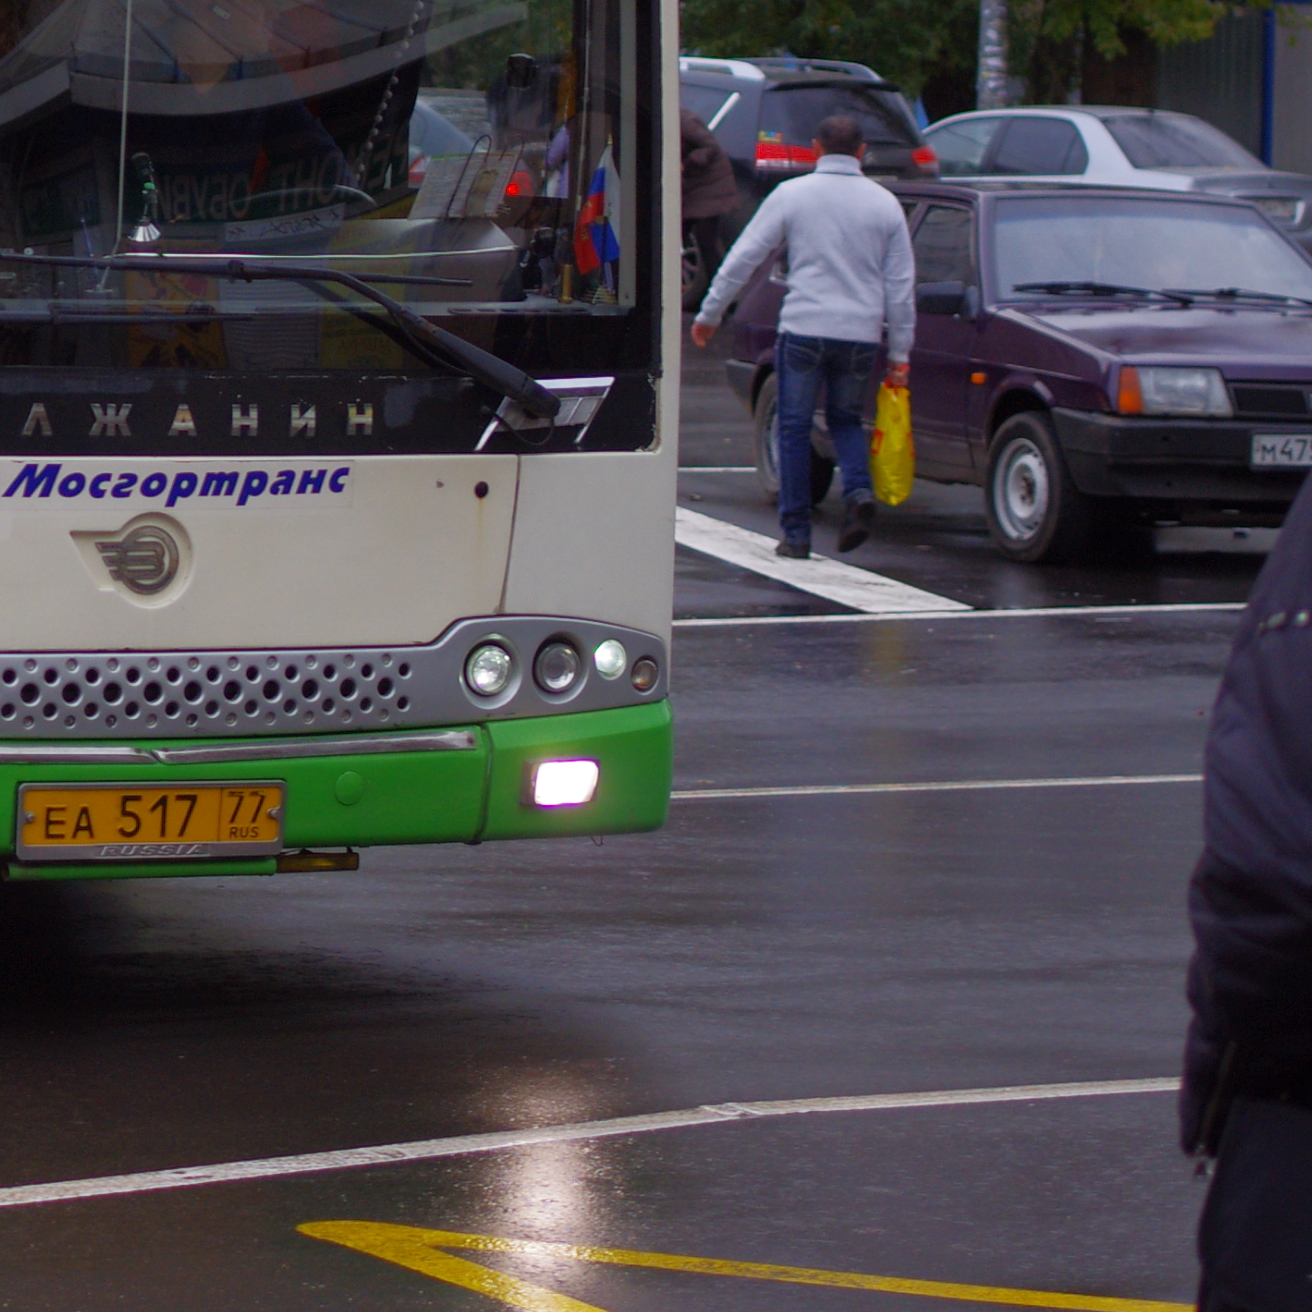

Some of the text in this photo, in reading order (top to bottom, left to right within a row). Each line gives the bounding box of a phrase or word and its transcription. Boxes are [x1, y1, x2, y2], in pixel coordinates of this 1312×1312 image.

[1260, 438, 1312, 462] М47
[2, 463, 351, 507] Мосгортранс
[117, 794, 199, 838] 517
[226, 789, 267, 824] 77
[228, 825, 259, 839] RUS
[99, 843, 204, 857] RUSSIA
